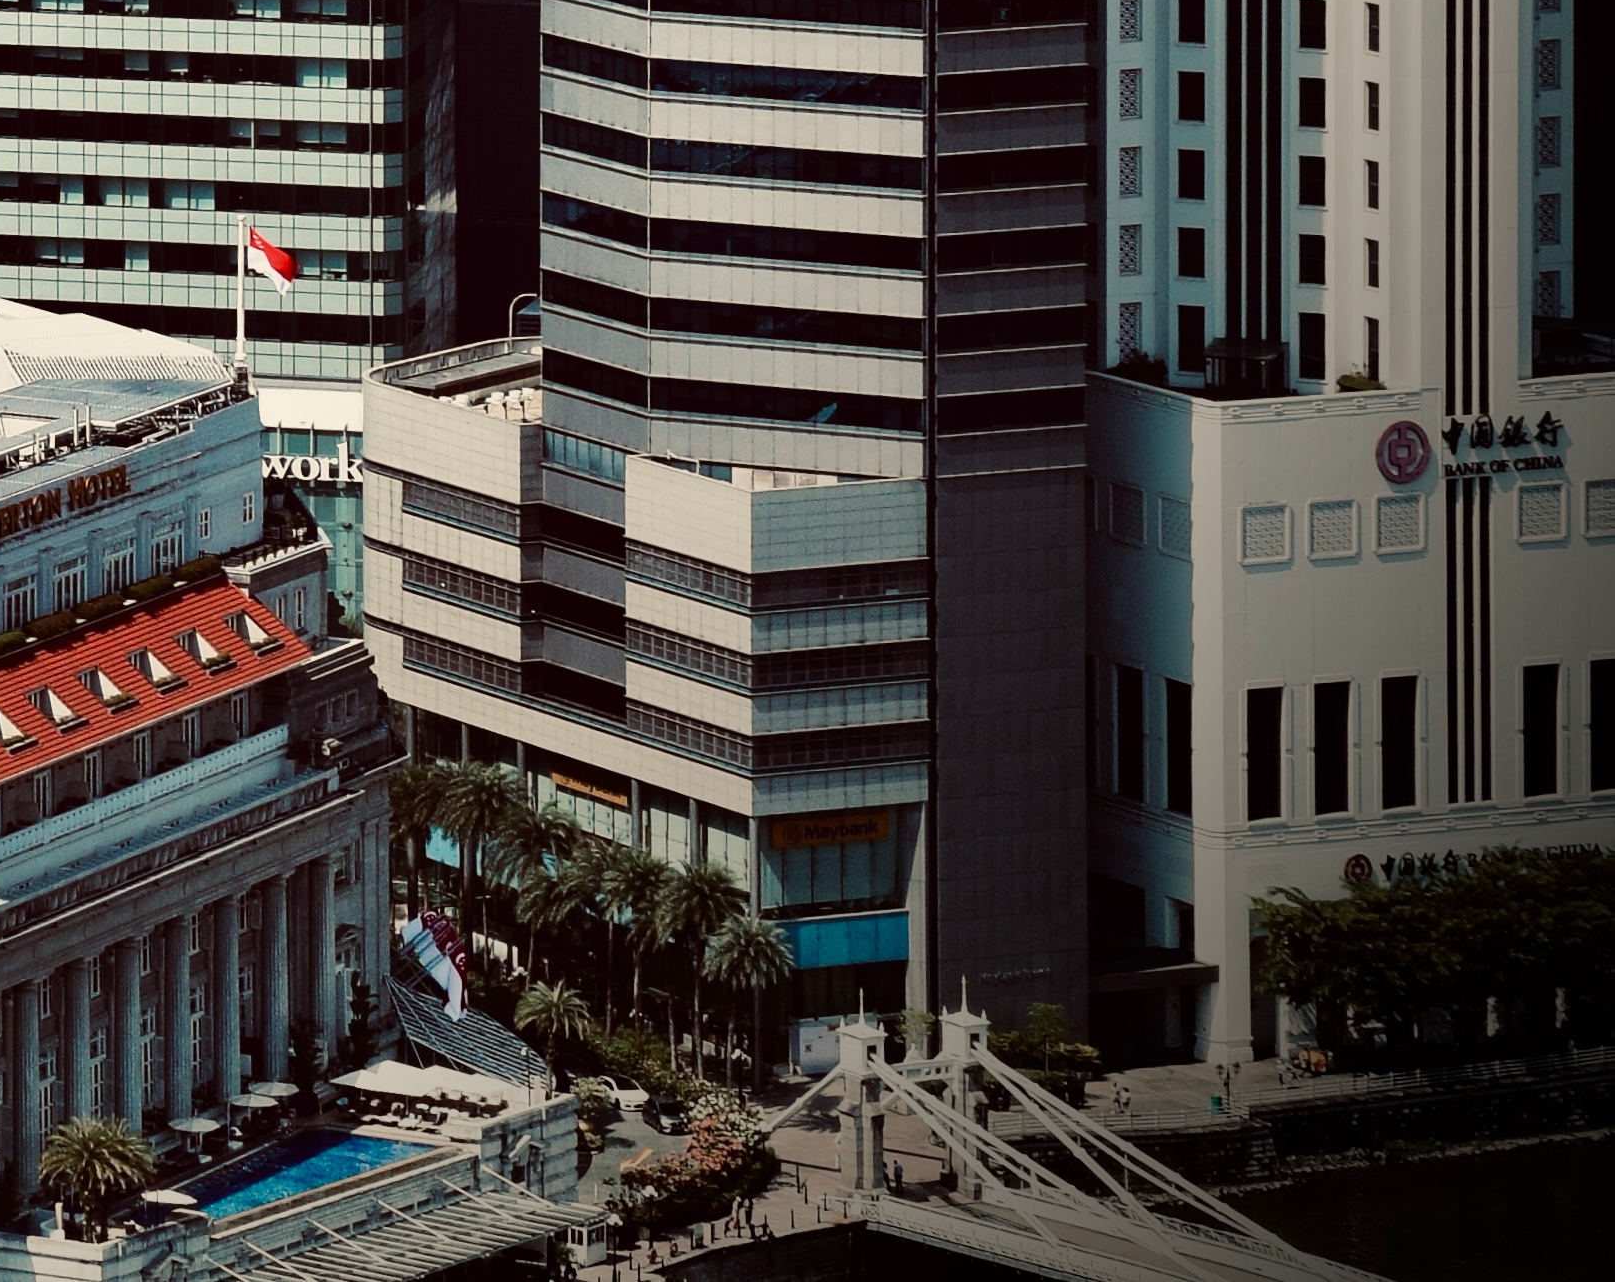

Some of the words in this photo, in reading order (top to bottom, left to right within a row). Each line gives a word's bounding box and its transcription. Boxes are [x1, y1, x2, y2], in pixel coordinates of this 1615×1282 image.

[1444, 462, 1487, 477] BANK
[1489, 459, 1511, 473] OF
[1514, 455, 1565, 472] CHINA
[66, 464, 132, 512] HOTEL
[804, 819, 879, 842] Maybank
